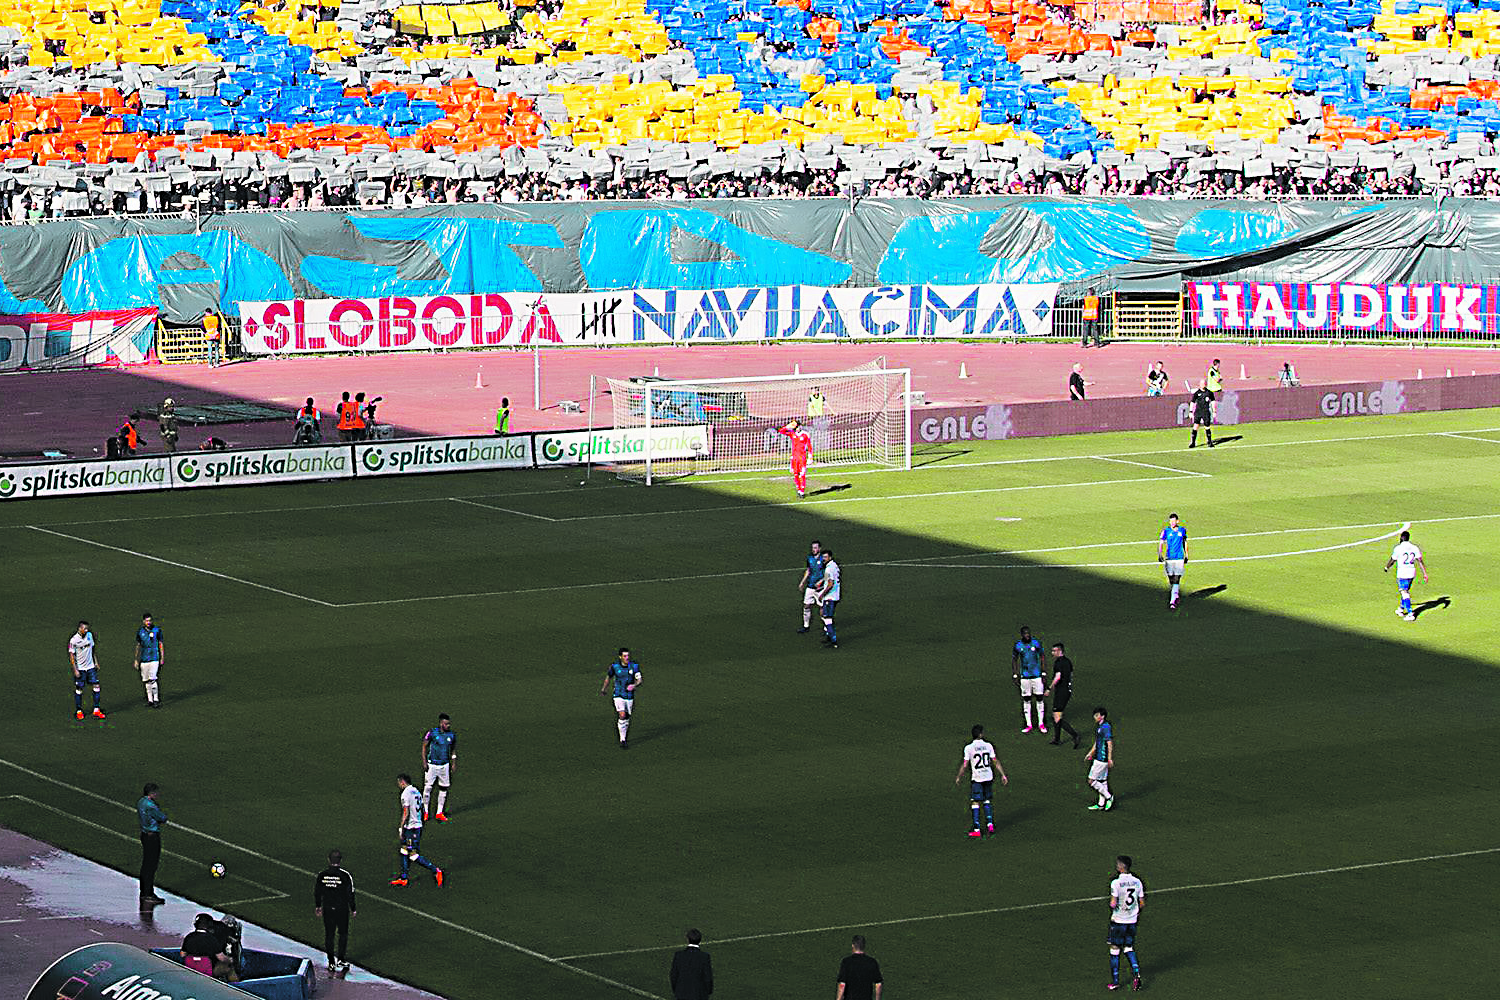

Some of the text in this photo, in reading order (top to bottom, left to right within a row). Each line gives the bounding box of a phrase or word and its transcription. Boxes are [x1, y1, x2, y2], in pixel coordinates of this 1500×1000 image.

[262, 284, 1030, 351] SLOBODA NAVIJAČIMA
[1196, 284, 1483, 331] HAJDUK
[204, 450, 346, 482] splitskabanka
[388, 434, 526, 471] splitskabanka
[22, 463, 165, 497] splitskabanka
[1403, 551, 1416, 565] 22
[973, 752, 990, 769] 20
[1125, 888, 1136, 906] 3
